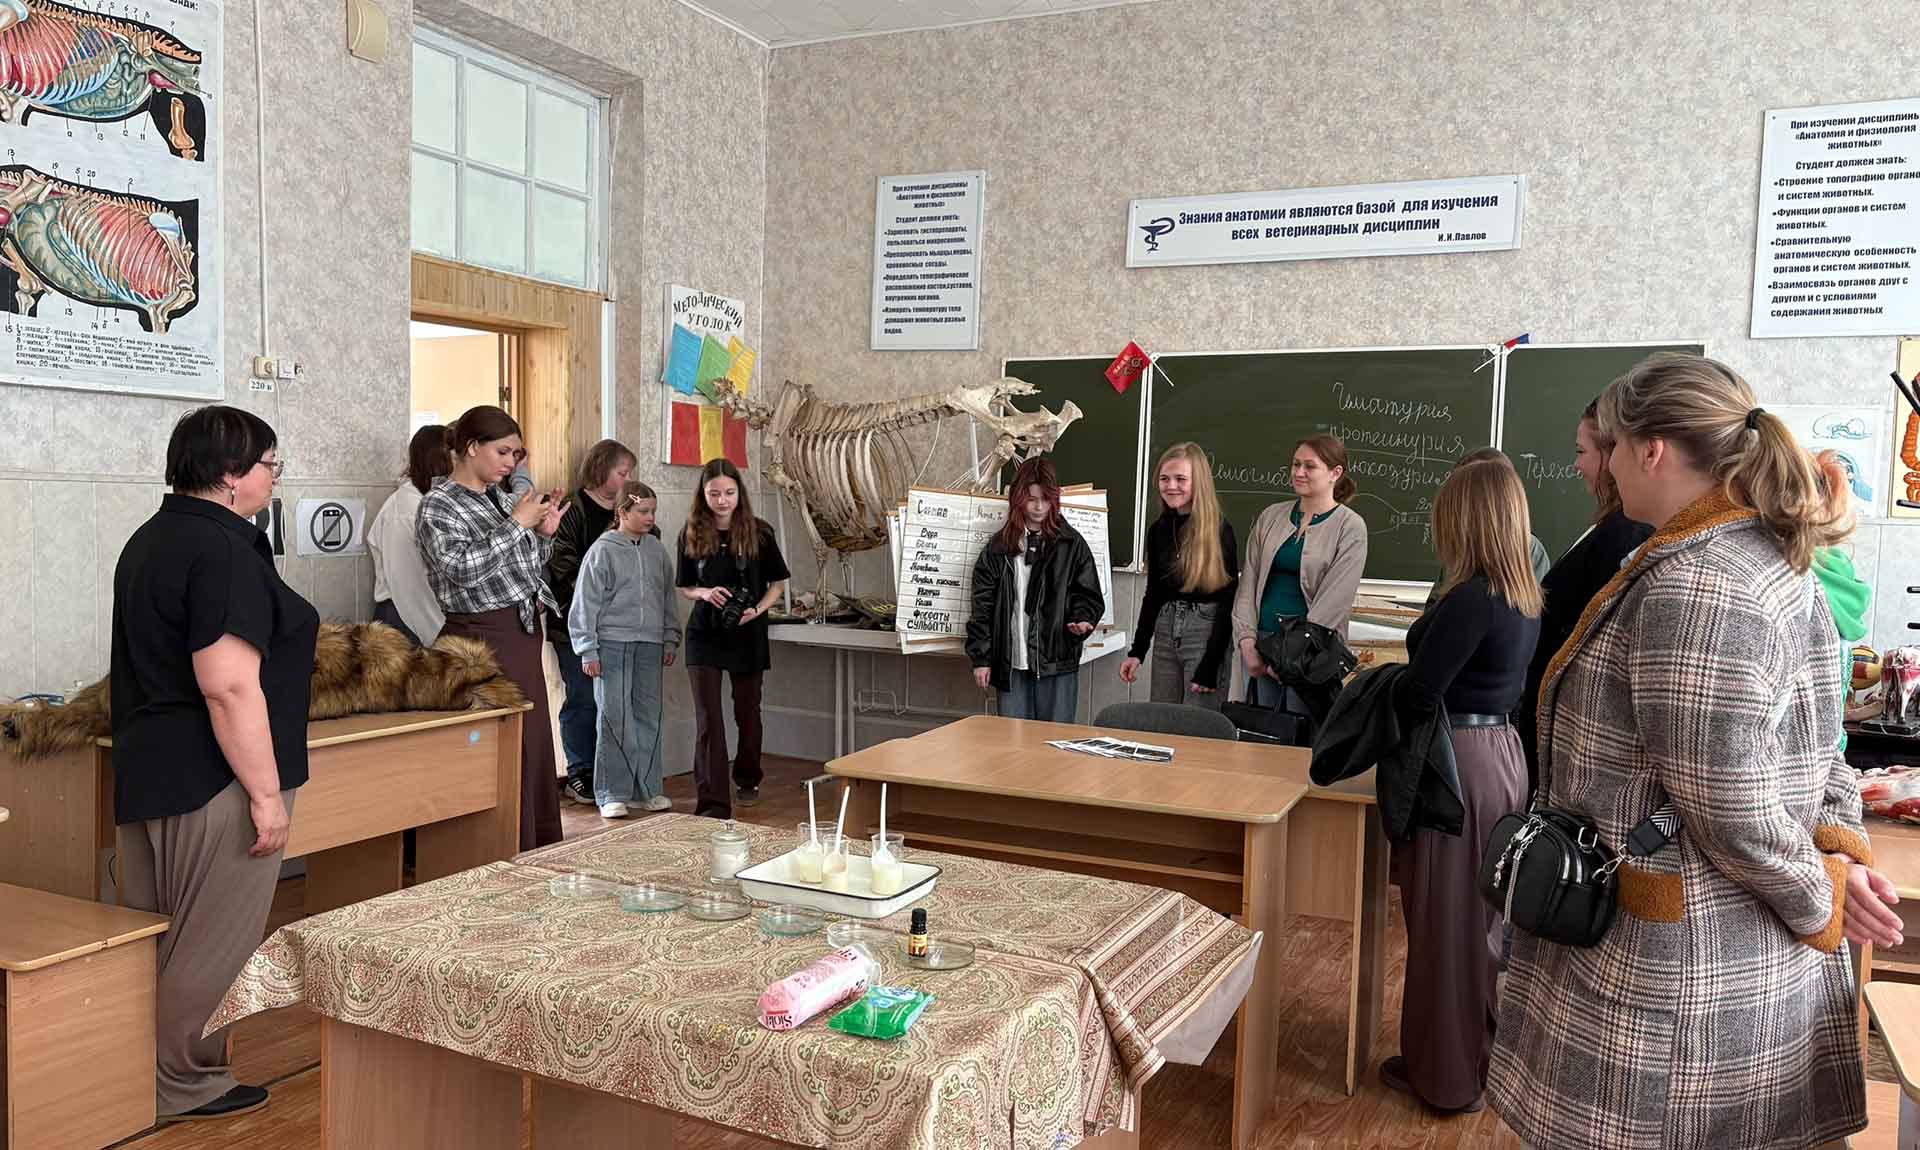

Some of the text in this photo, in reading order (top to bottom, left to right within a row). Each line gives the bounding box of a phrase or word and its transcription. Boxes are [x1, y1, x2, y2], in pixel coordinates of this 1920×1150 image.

[1790, 120, 1808, 130] При
[1810, 117, 1856, 128] изучении
[1796, 124, 1917, 140] «Анатомия и физиология
[1828, 139, 1882, 150] животных»
[1795, 156, 1907, 170] Студент должен знать:
[1779, 170, 1920, 187] Строение топографию органо
[1786, 190, 1820, 200] систем
[1822, 188, 1874, 198] животных.
[1178, 195, 1498, 225] Знания анатомии являются базой для изучения
[1777, 202, 1906, 217] Функции органов и систем
[1231, 218, 1440, 241] всех ветеринарных дисциплин
[1776, 221, 1828, 231] животных.
[1775, 236, 1851, 247] Сравнительную
[1774, 246, 1917, 260] анатомическую особенность
[1773, 261, 1911, 274] органов и систем животных.
[1772, 277, 1909, 289] Взаимосвязь органов друг с
[1771, 292, 1877, 304] другом и с условиями
[673, 291, 743, 328] МЕТОДИЧЕСКИЙ
[1770, 306, 1883, 318] содержания животных
[687, 313, 732, 332] УГОЛОК
[251, 380, 265, 390] 220
